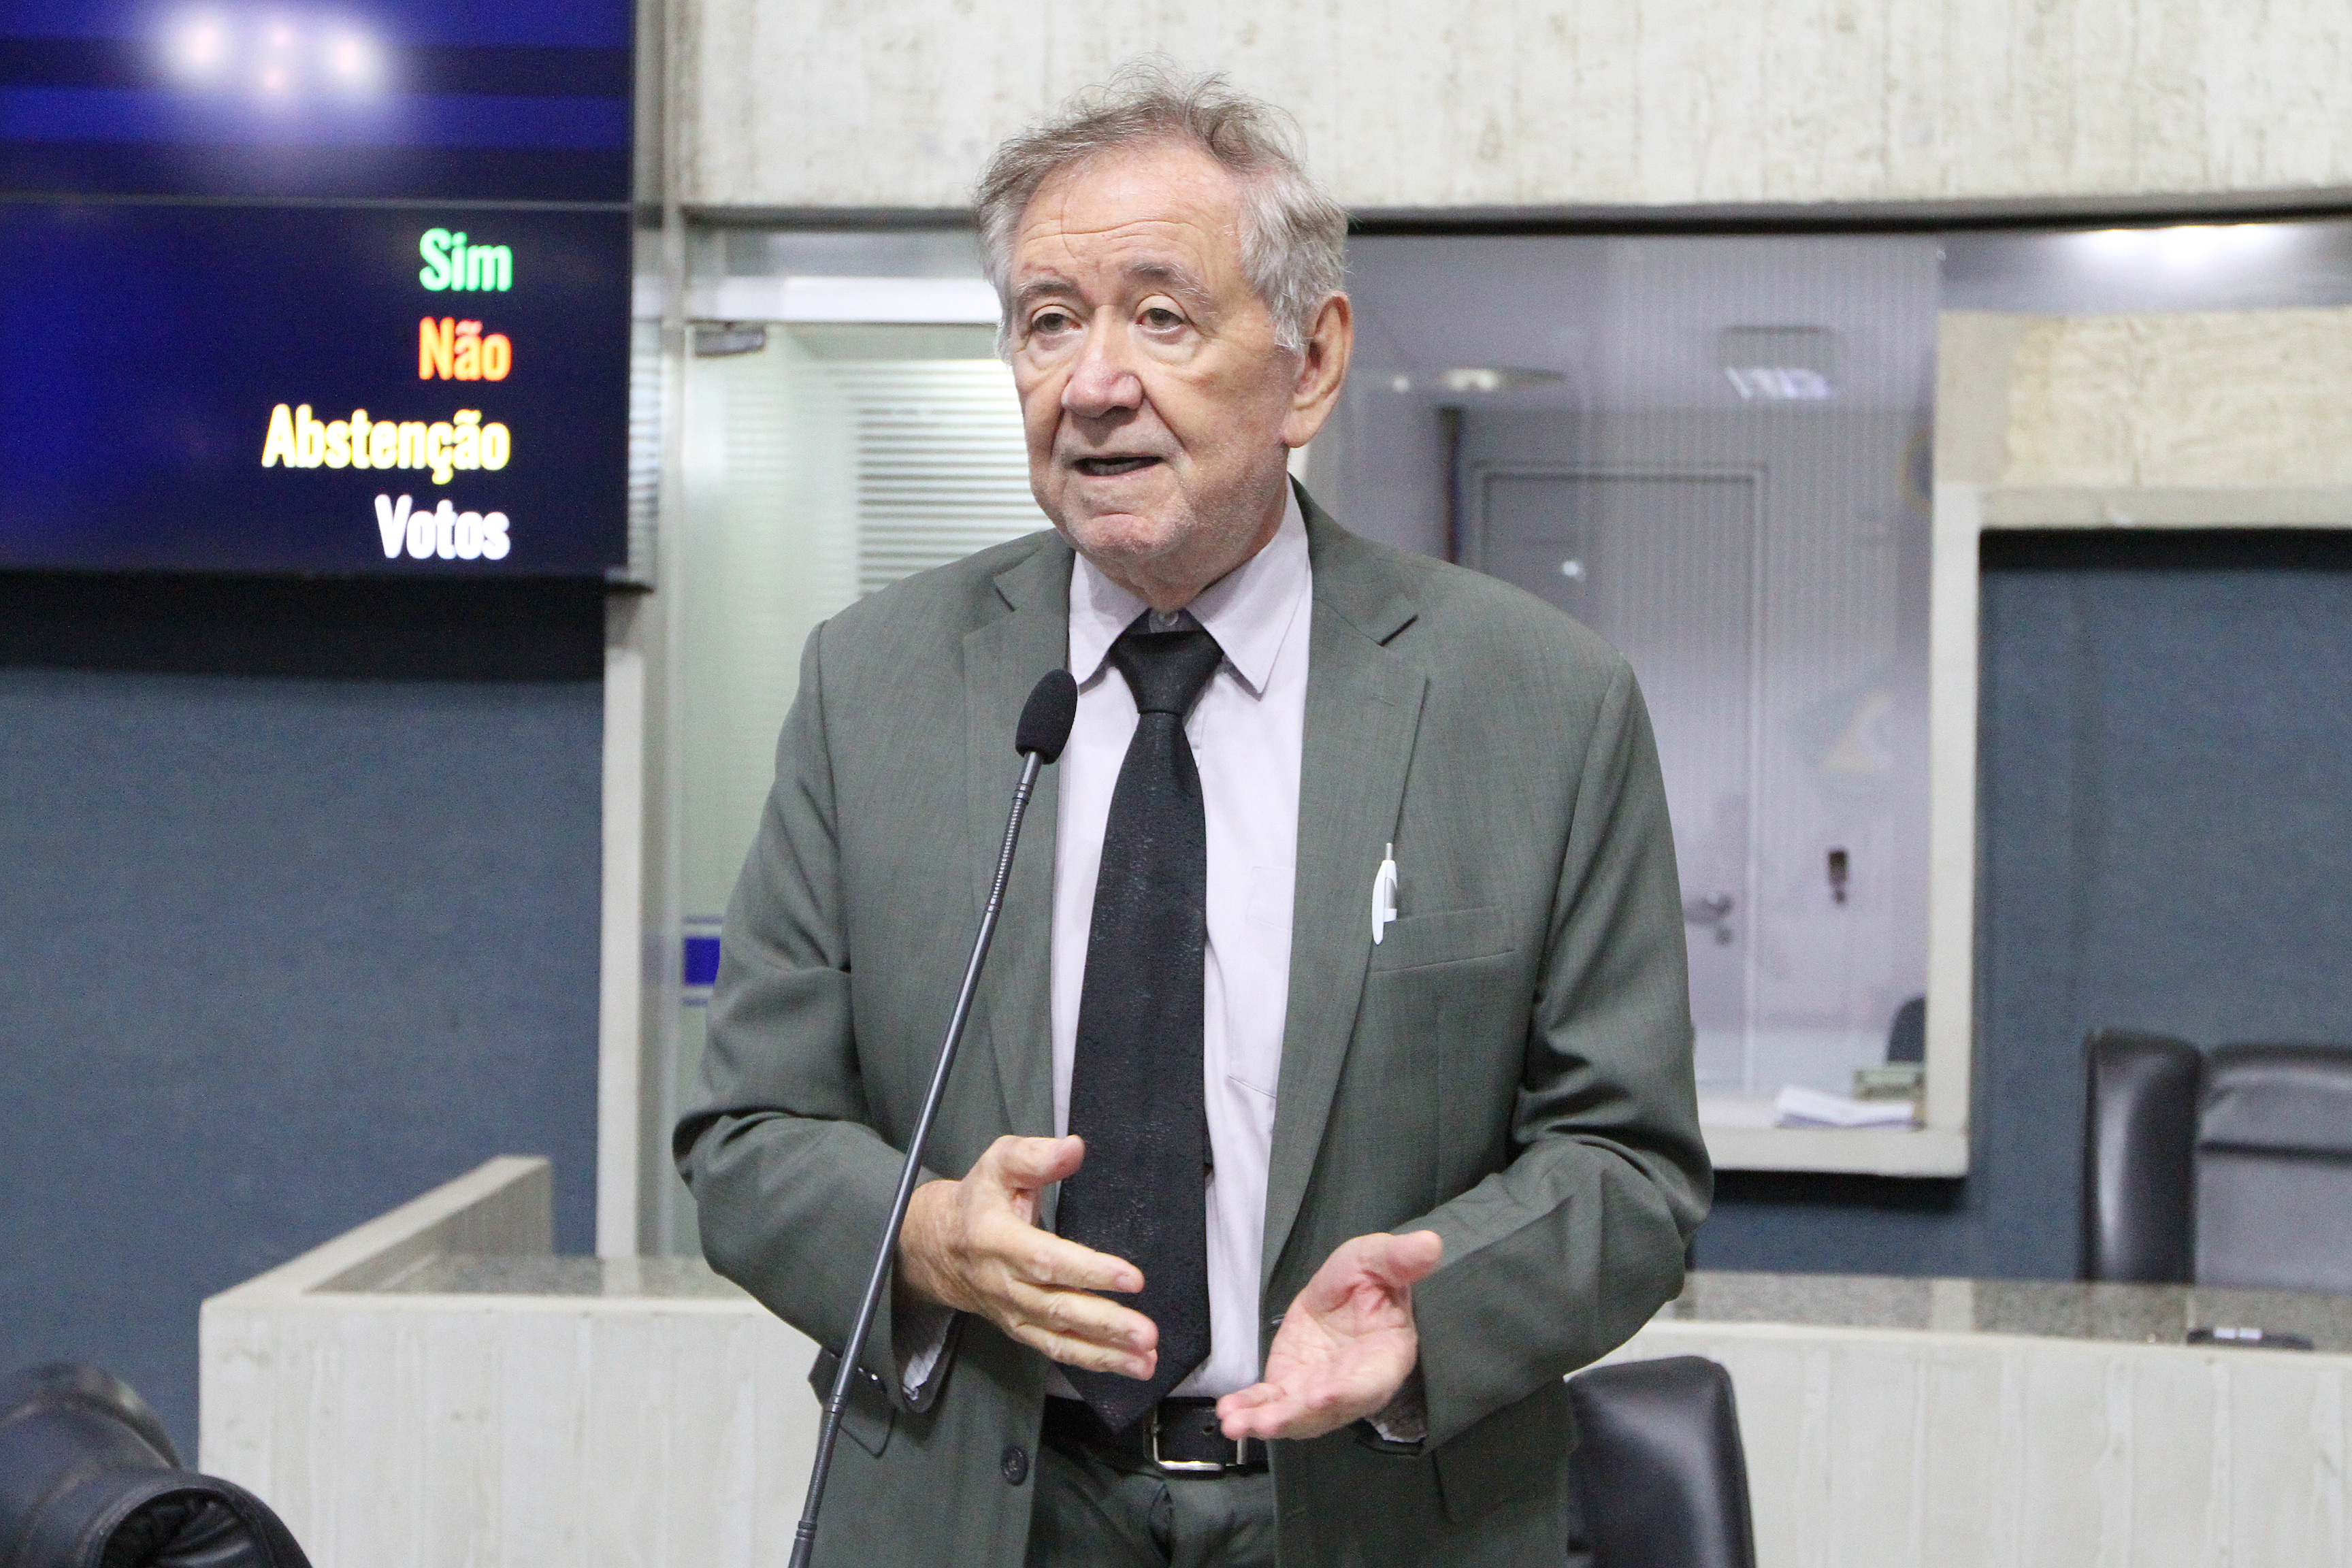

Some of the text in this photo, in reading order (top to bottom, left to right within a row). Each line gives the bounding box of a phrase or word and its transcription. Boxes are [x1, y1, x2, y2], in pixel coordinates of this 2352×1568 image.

[419, 227, 513, 293] Sim
[418, 316, 513, 382] Não
[261, 403, 511, 485] Abstenção
[374, 493, 511, 561] Votos
